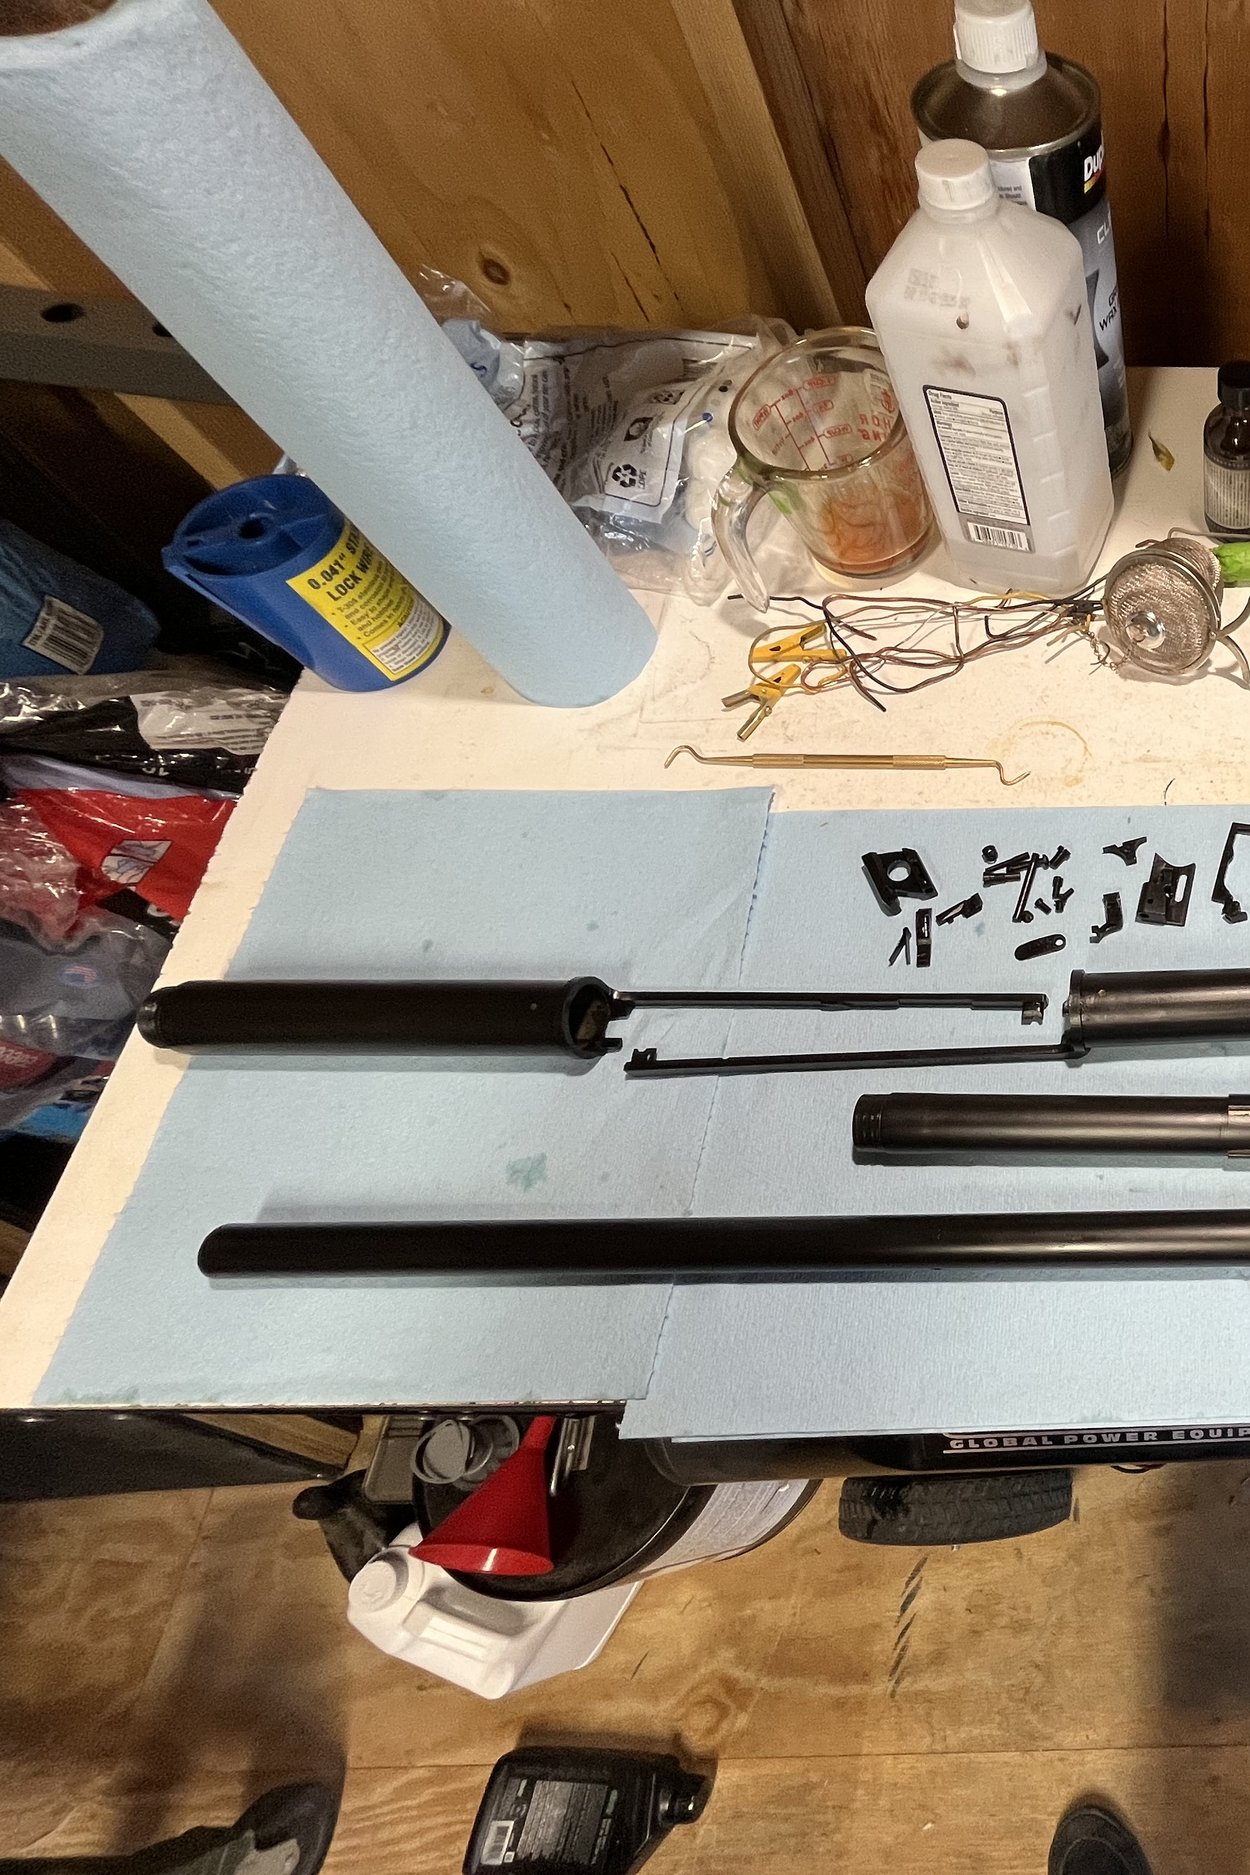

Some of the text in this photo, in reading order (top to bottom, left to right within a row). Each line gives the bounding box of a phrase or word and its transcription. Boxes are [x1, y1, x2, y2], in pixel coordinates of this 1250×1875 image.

[326, 570, 363, 602] LOCK
[950, 1436, 1053, 1449] GLOBAL
[1064, 1431, 1158, 1444] POWER
